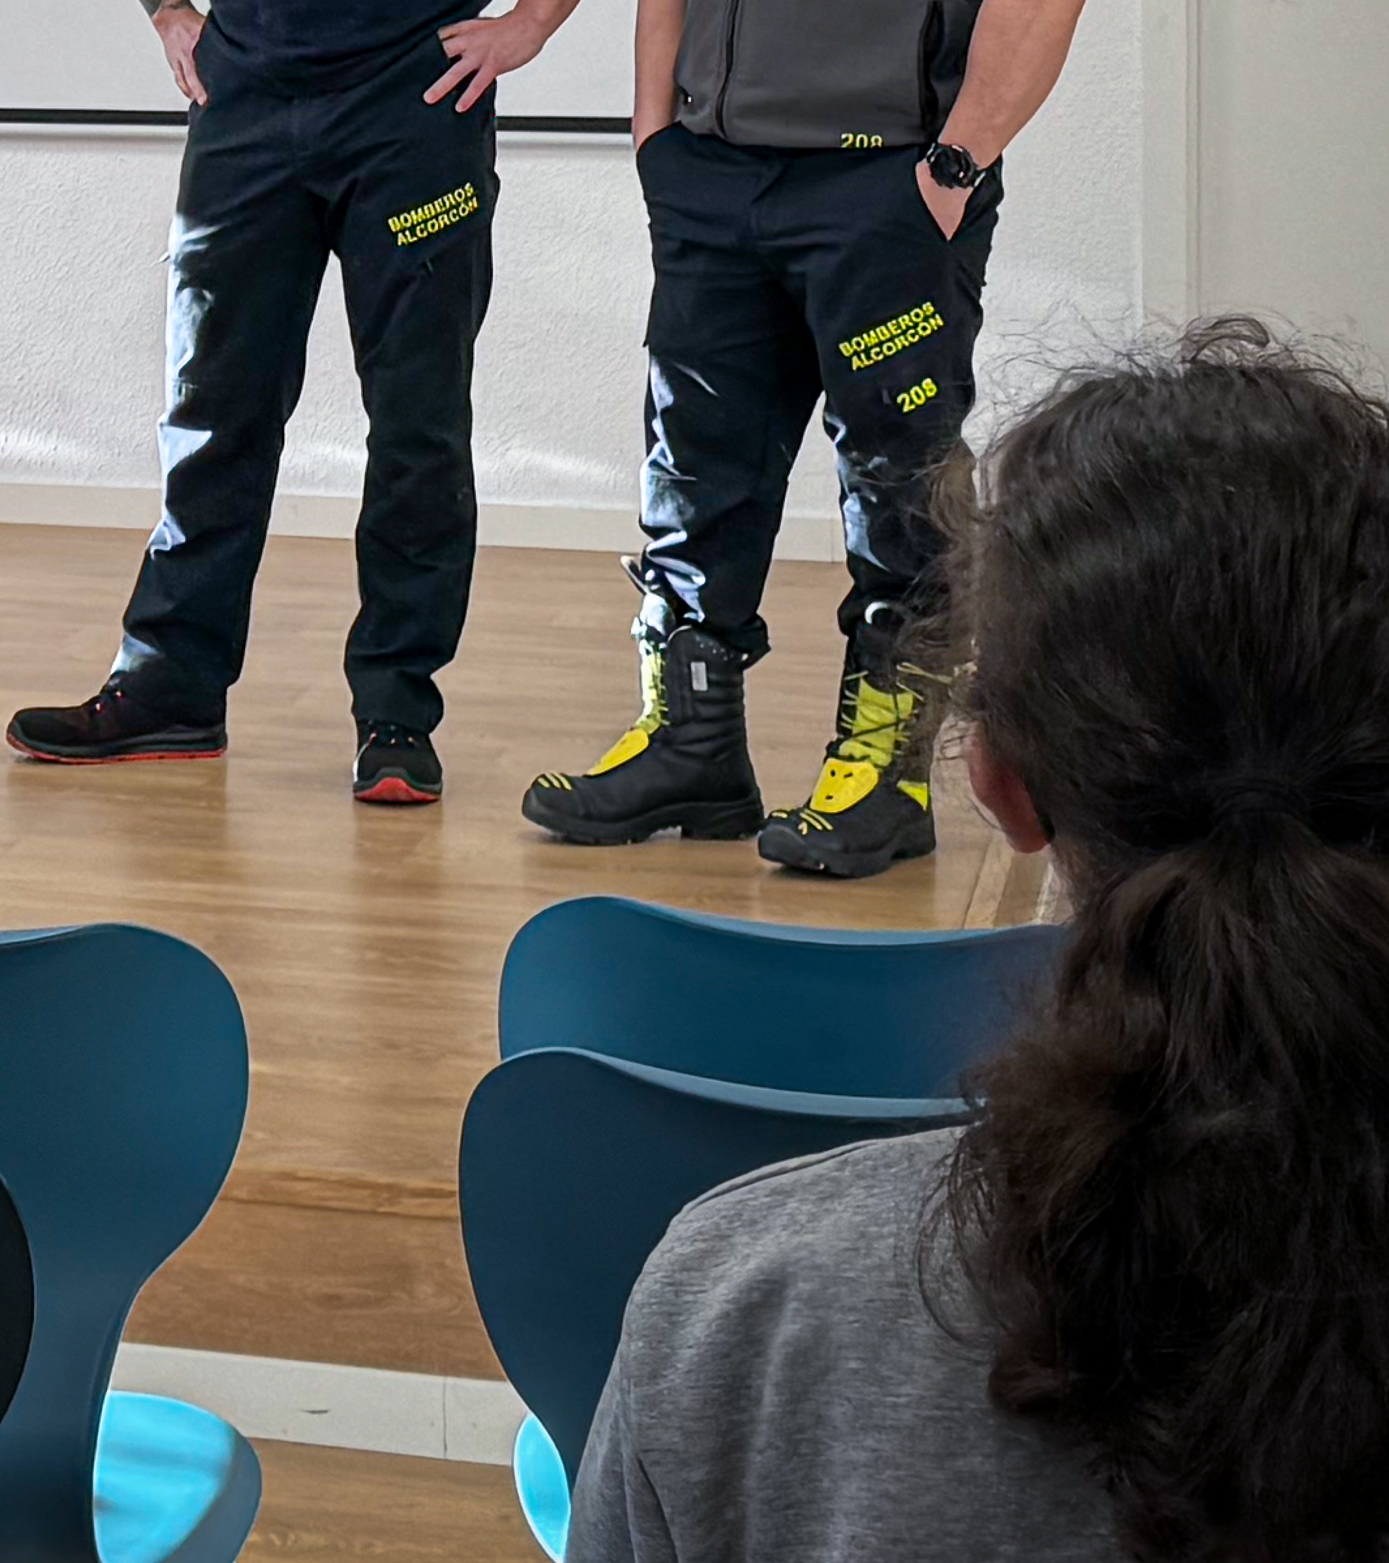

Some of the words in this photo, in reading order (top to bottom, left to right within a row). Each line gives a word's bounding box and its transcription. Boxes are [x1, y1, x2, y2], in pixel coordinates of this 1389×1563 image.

[840, 132, 884, 149] 208
[387, 181, 475, 233] BOMBEROS
[838, 301, 936, 358] BOMBEROS
[896, 376, 939, 414] 208
